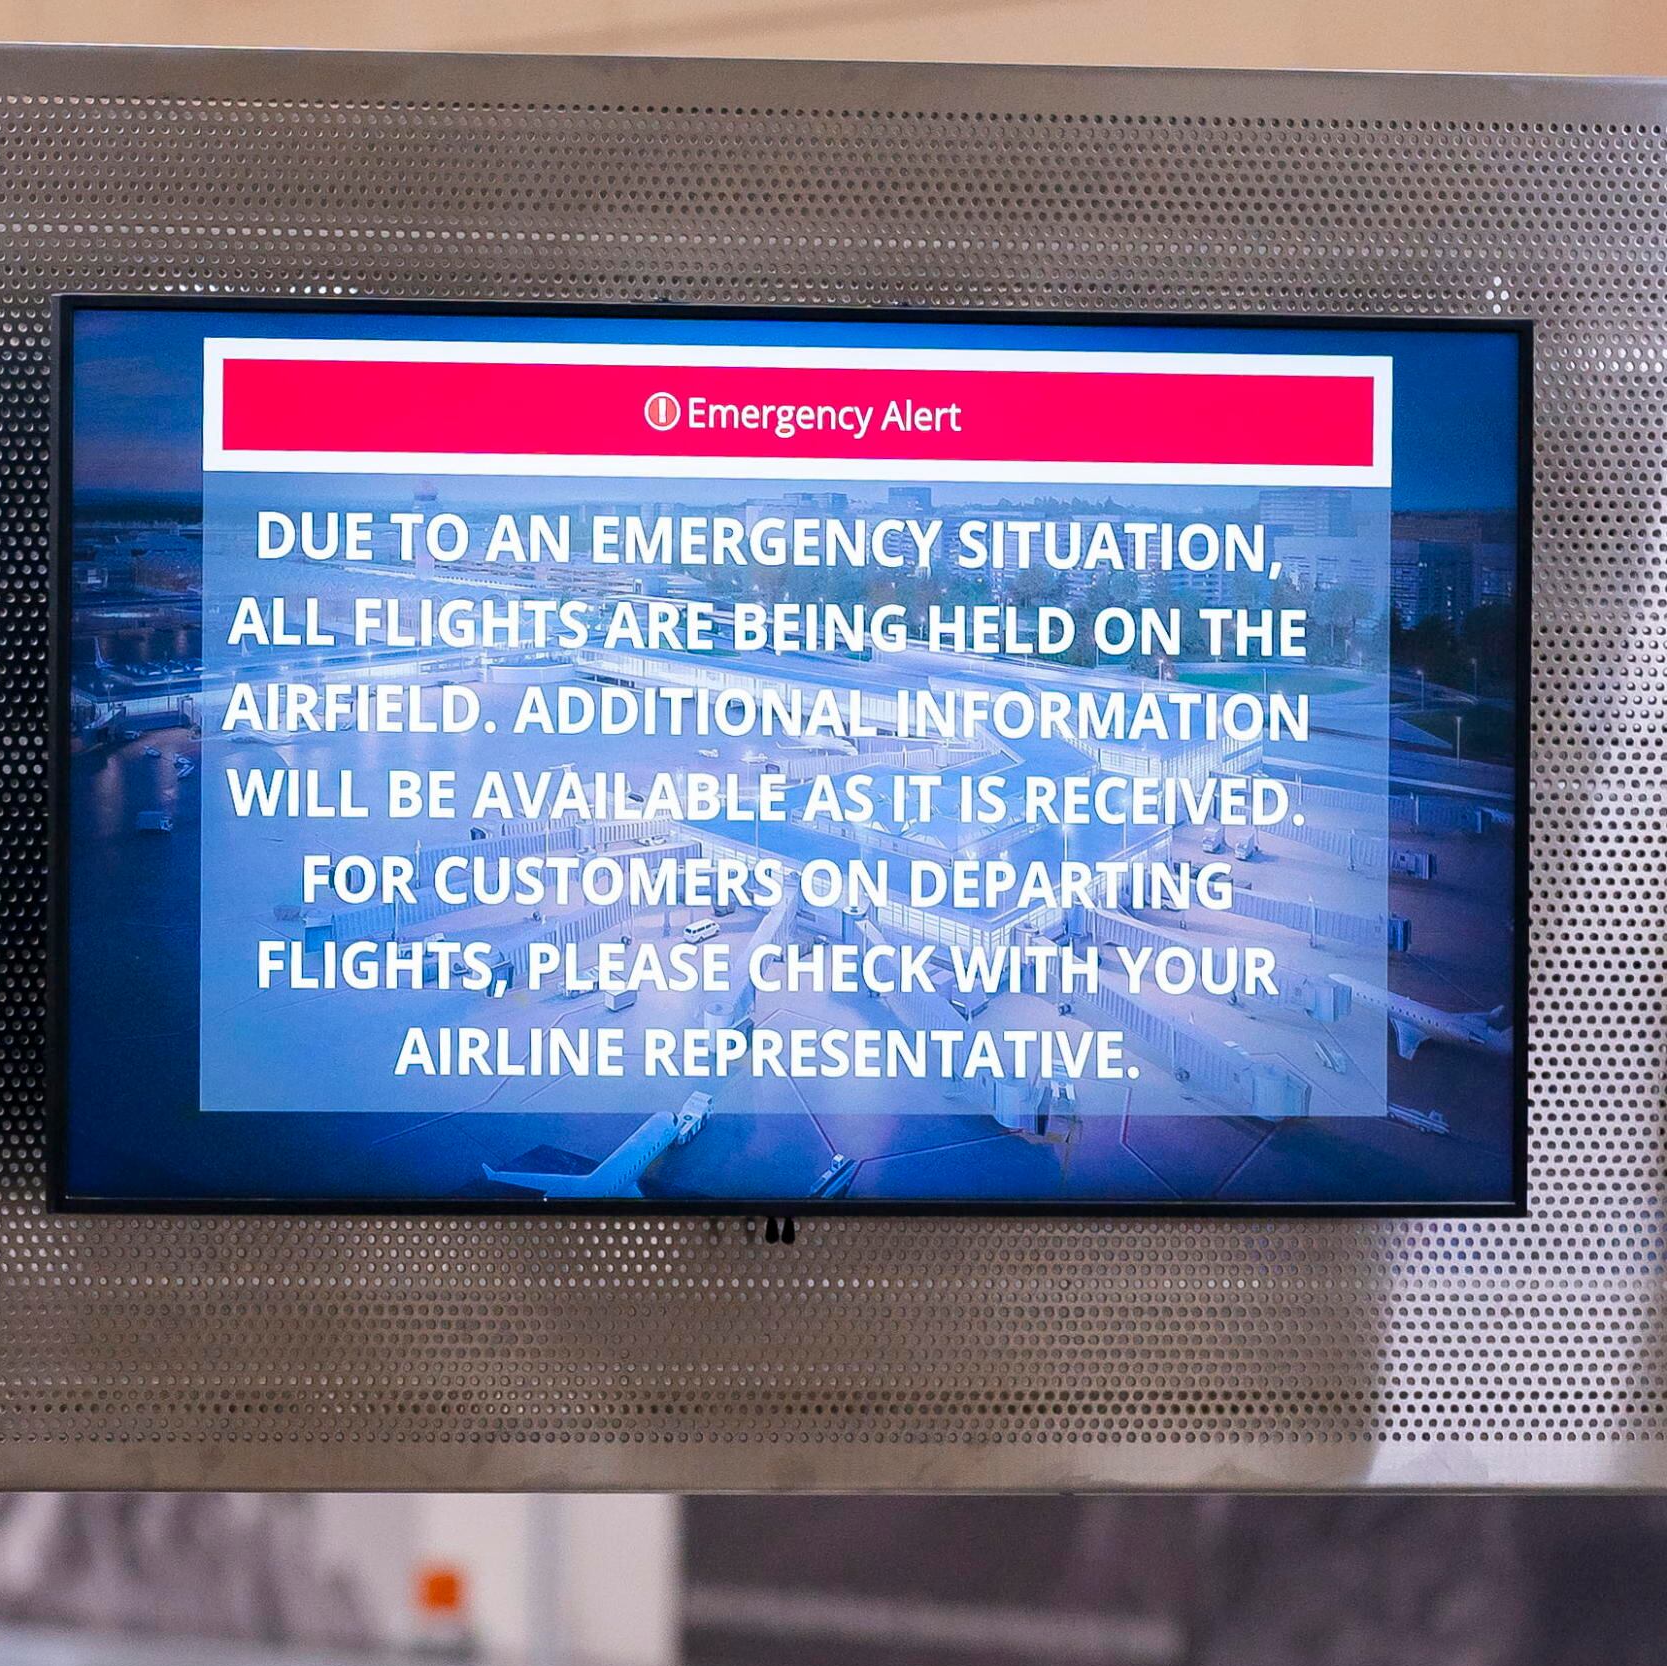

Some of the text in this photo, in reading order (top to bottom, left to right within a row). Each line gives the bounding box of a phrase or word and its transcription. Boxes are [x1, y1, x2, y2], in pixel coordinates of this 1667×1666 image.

[689, 398, 961, 439] Emergency Alert
[256, 512, 1284, 579] DUE TO AN EMERGENCY SITUATION,
[228, 597, 1306, 657] ALL FLIGHTS ARE BEING HELD ON THE
[223, 684, 1310, 741] AIRFIELD. ADDITIONAL INFORMATION
[227, 768, 1304, 824] WILL BE AVAILABLE AS IT IS RECEIVED.
[304, 855, 1232, 909] FOR CUSTOMERS ON DEPARTING
[259, 943, 1278, 1002] FLIGHTS, PLEASE CHECK WITH YOUR
[395, 1028, 1139, 1080] AIRLINE REPRESENTATIVE.
